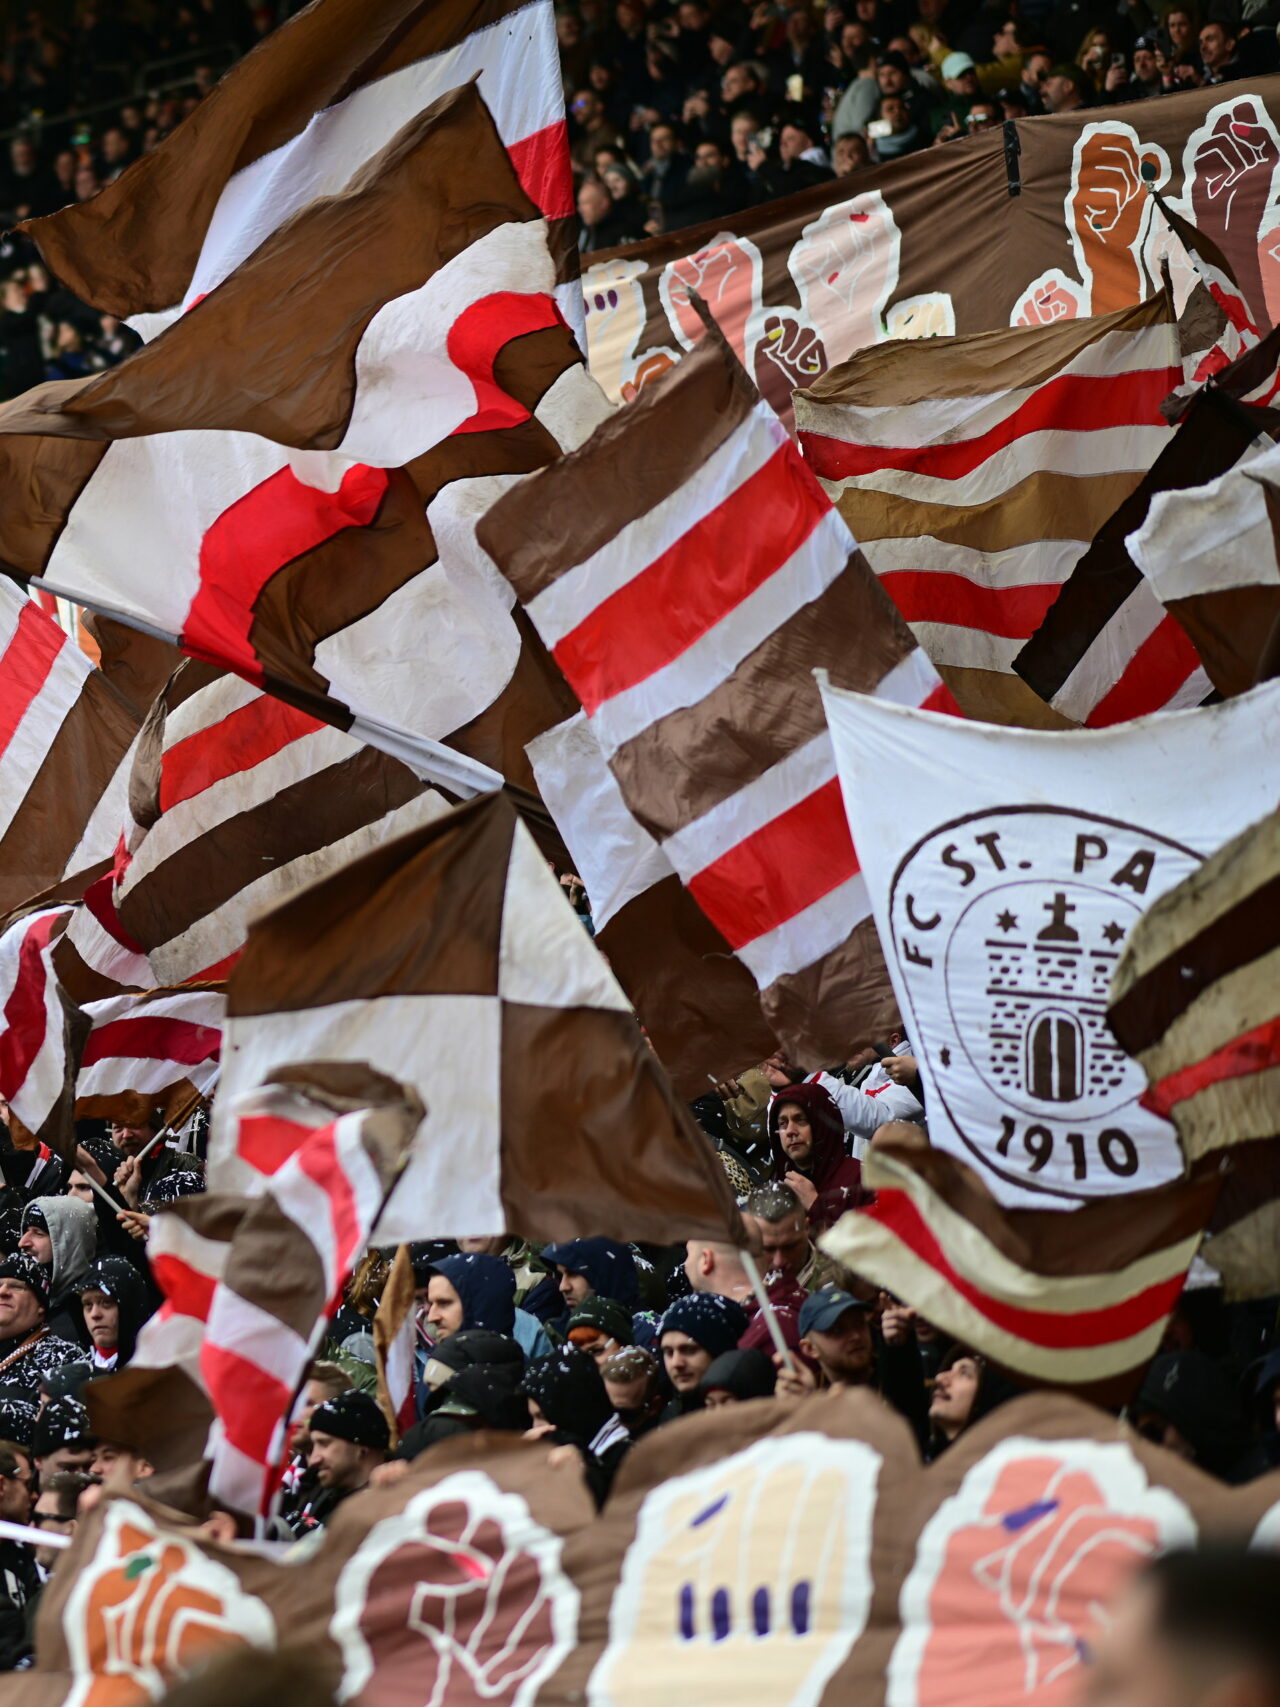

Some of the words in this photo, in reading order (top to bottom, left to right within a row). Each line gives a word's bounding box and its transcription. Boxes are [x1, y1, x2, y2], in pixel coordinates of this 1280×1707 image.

[902, 893, 942, 968] FC
[941, 832, 1032, 887] ST.
[1073, 834, 1156, 895] PA
[995, 1115, 1139, 1181] 1910
